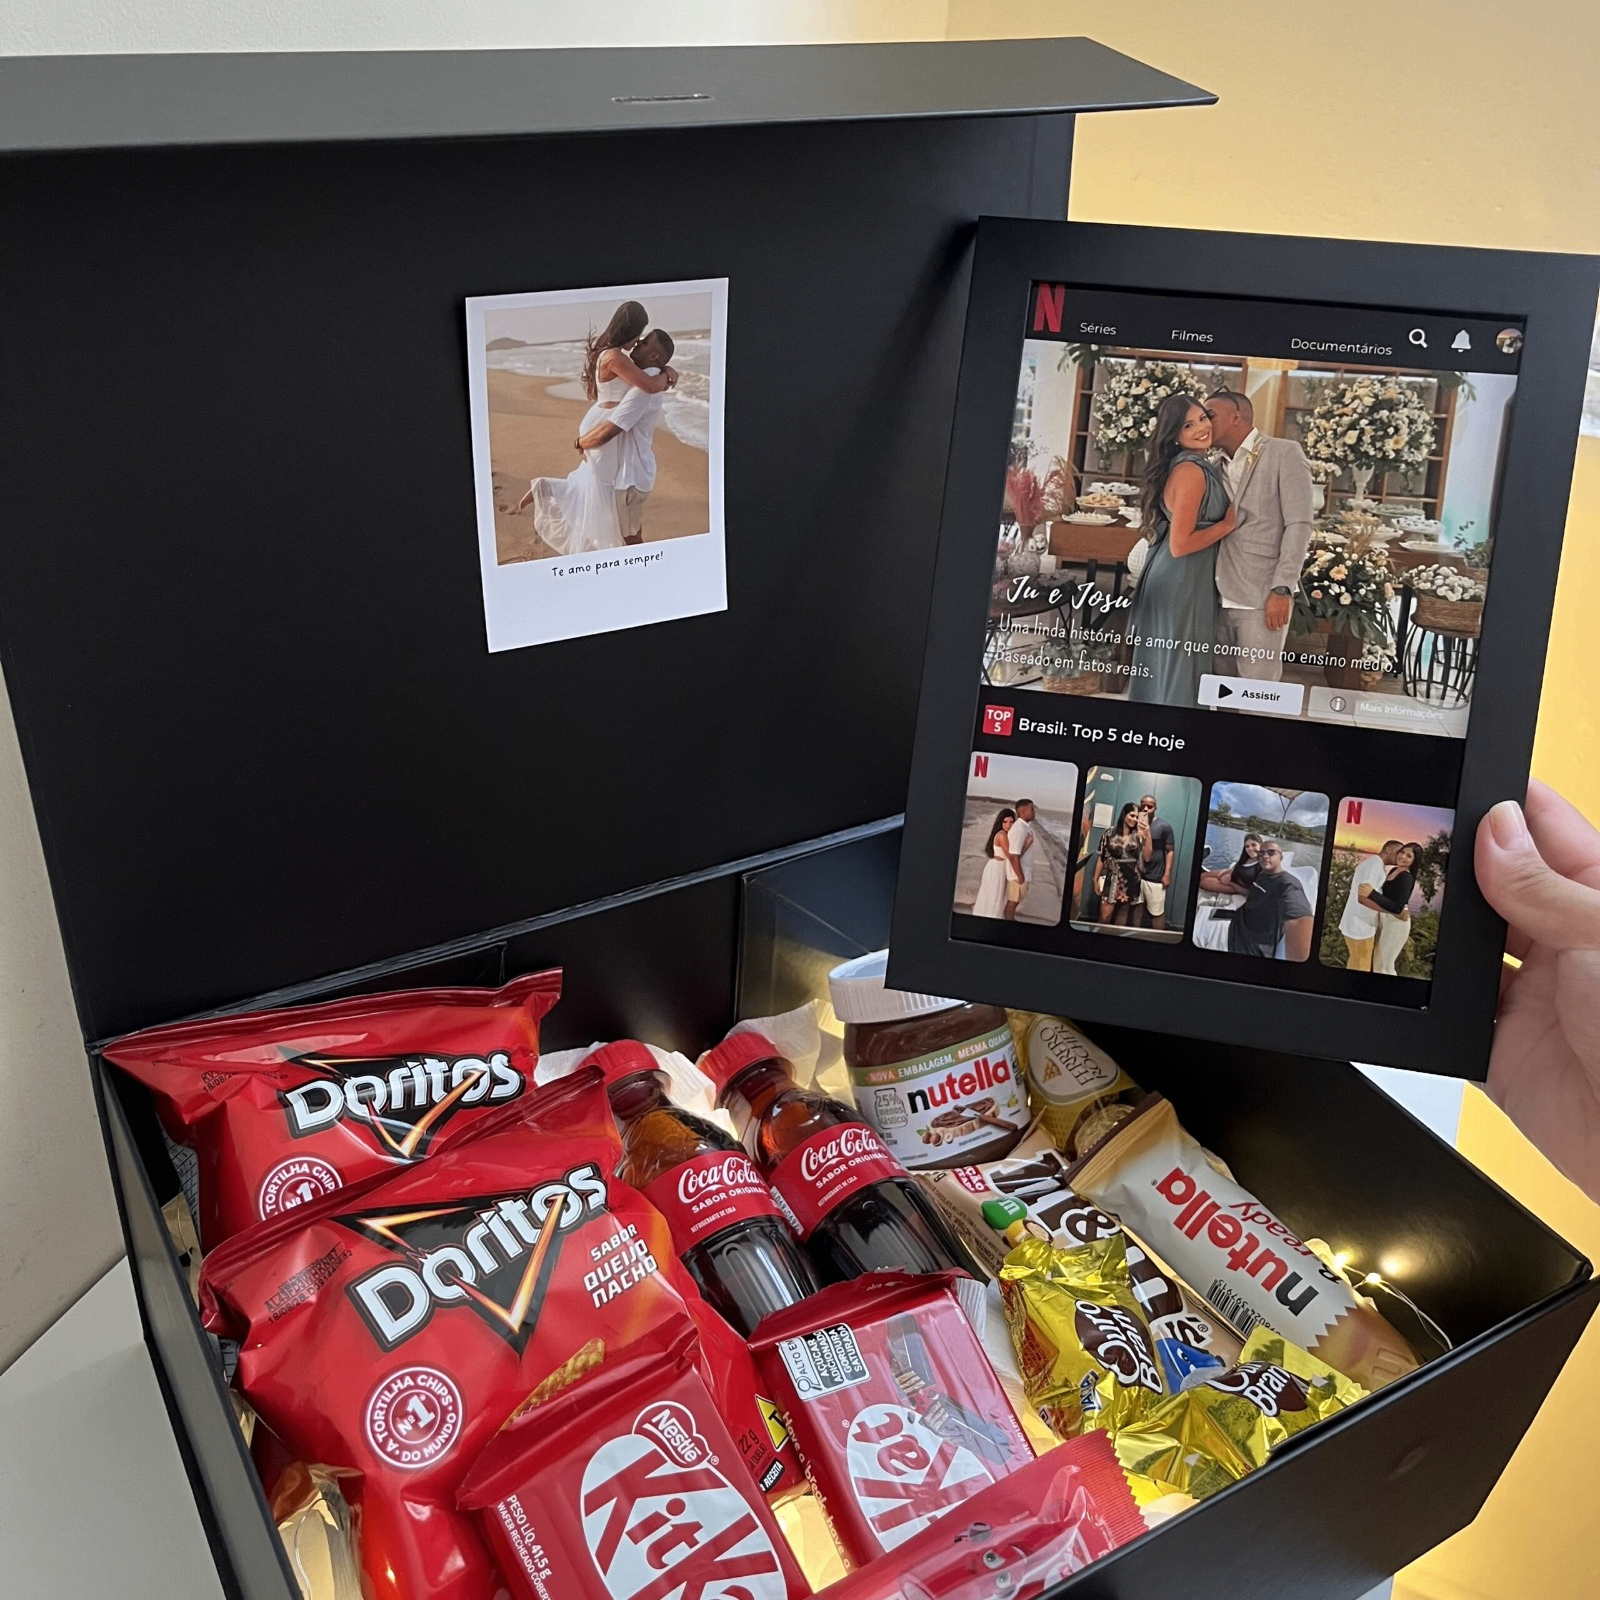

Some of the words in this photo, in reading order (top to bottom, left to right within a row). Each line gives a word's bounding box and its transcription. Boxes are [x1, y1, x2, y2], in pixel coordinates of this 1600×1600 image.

[1080, 321, 1116, 337] Séries
[1171, 329, 1214, 344] Filmes
[1290, 337, 1393, 356] Documentários
[552, 567, 564, 577] Te
[568, 564, 591, 575] amo
[595, 558, 620, 575] para
[624, 550, 664, 568] sempre!
[1006, 575, 1040, 603] Ju
[1048, 587, 1062, 604] e
[999, 613, 1030, 635] Uma
[1034, 615, 1066, 638] linda
[1070, 619, 1121, 645] história
[1125, 624, 1142, 646] de
[1145, 636, 1180, 652] amor
[1184, 640, 1210, 657] que
[1213, 642, 1275, 664] começou
[1279, 651, 1296, 662] no
[1300, 652, 1347, 668] ensino
[995, 642, 1050, 667] Baseado
[1055, 656, 1074, 669] em
[1079, 650, 1112, 673] fatos
[1116, 663, 1154, 679] reais.
[1241, 688, 1281, 702] Assistir
[1360, 702, 1383, 714] Mais
[986, 708, 1011, 722] TOP
[994, 721, 1002, 733] 5
[1018, 717, 1069, 736] Brasil:
[1073, 724, 1104, 744] Top
[1107, 727, 1118, 742] 5
[1121, 730, 1143, 746] de
[1147, 732, 1186, 751] hoje
[974, 755, 989, 778] N
[1346, 801, 1363, 825] N
[869, 1070, 895, 1082] NOVA
[898, 1054, 956, 1078] EMBALAGEM,
[957, 1041, 988, 1059] MESMA
[1041, 1026, 1093, 1087] FERRERO
[1054, 1023, 1108, 1079] ROCHER
[286, 1053, 523, 1131] Doritos
[876, 1092, 901, 1108] 25%
[907, 1057, 1011, 1114] nutella
[801, 1128, 880, 1181] Coca-Cola
[815, 1164, 848, 1189] SABOR
[848, 1152, 888, 1167] ORIGINAL
[265, 1163, 310, 1213] TORTILHA
[312, 1166, 336, 1194] CHIP
[678, 1157, 760, 1204] Coca-Cola
[691, 1192, 728, 1213] SABOR
[728, 1186, 768, 1197] ORIGINAL
[356, 1166, 608, 1343] Doritos
[590, 1224, 638, 1261] SABOR
[1155, 1167, 1320, 1318] nutella
[583, 1239, 649, 1293] QUEIJO
[793, 1352, 808, 1375] ALTO
[807, 1338, 830, 1377] AÇÚCAR
[829, 1329, 852, 1373] GORDURA
[837, 1325, 863, 1372] SATURADA
[374, 1376, 415, 1442] TORTILHA
[417, 1375, 453, 1406] CHIPS
[1008, 1414, 1021, 1432] LEITE
[387, 1438, 399, 1452] A
[402, 1451, 421, 1461] DO
[423, 1413, 456, 1458] MUNDO
[651, 1408, 702, 1462] Nestlé
[738, 1433, 752, 1455] 22
[750, 1429, 759, 1444] g
[765, 1461, 783, 1488] RECEITA
[782, 1411, 800, 1450] Have
[799, 1453, 806, 1463] a
[826, 1515, 845, 1554] have
[843, 1557, 851, 1569] a
[507, 1494, 527, 1525] PESO
[584, 1447, 780, 1600] KitK
[497, 1501, 515, 1531] WAFER
[510, 1530, 535, 1573] RECHEADO
[521, 1523, 536, 1547] LÍQ.
[532, 1545, 549, 1568] 41,5
[540, 1568, 552, 1580] g
